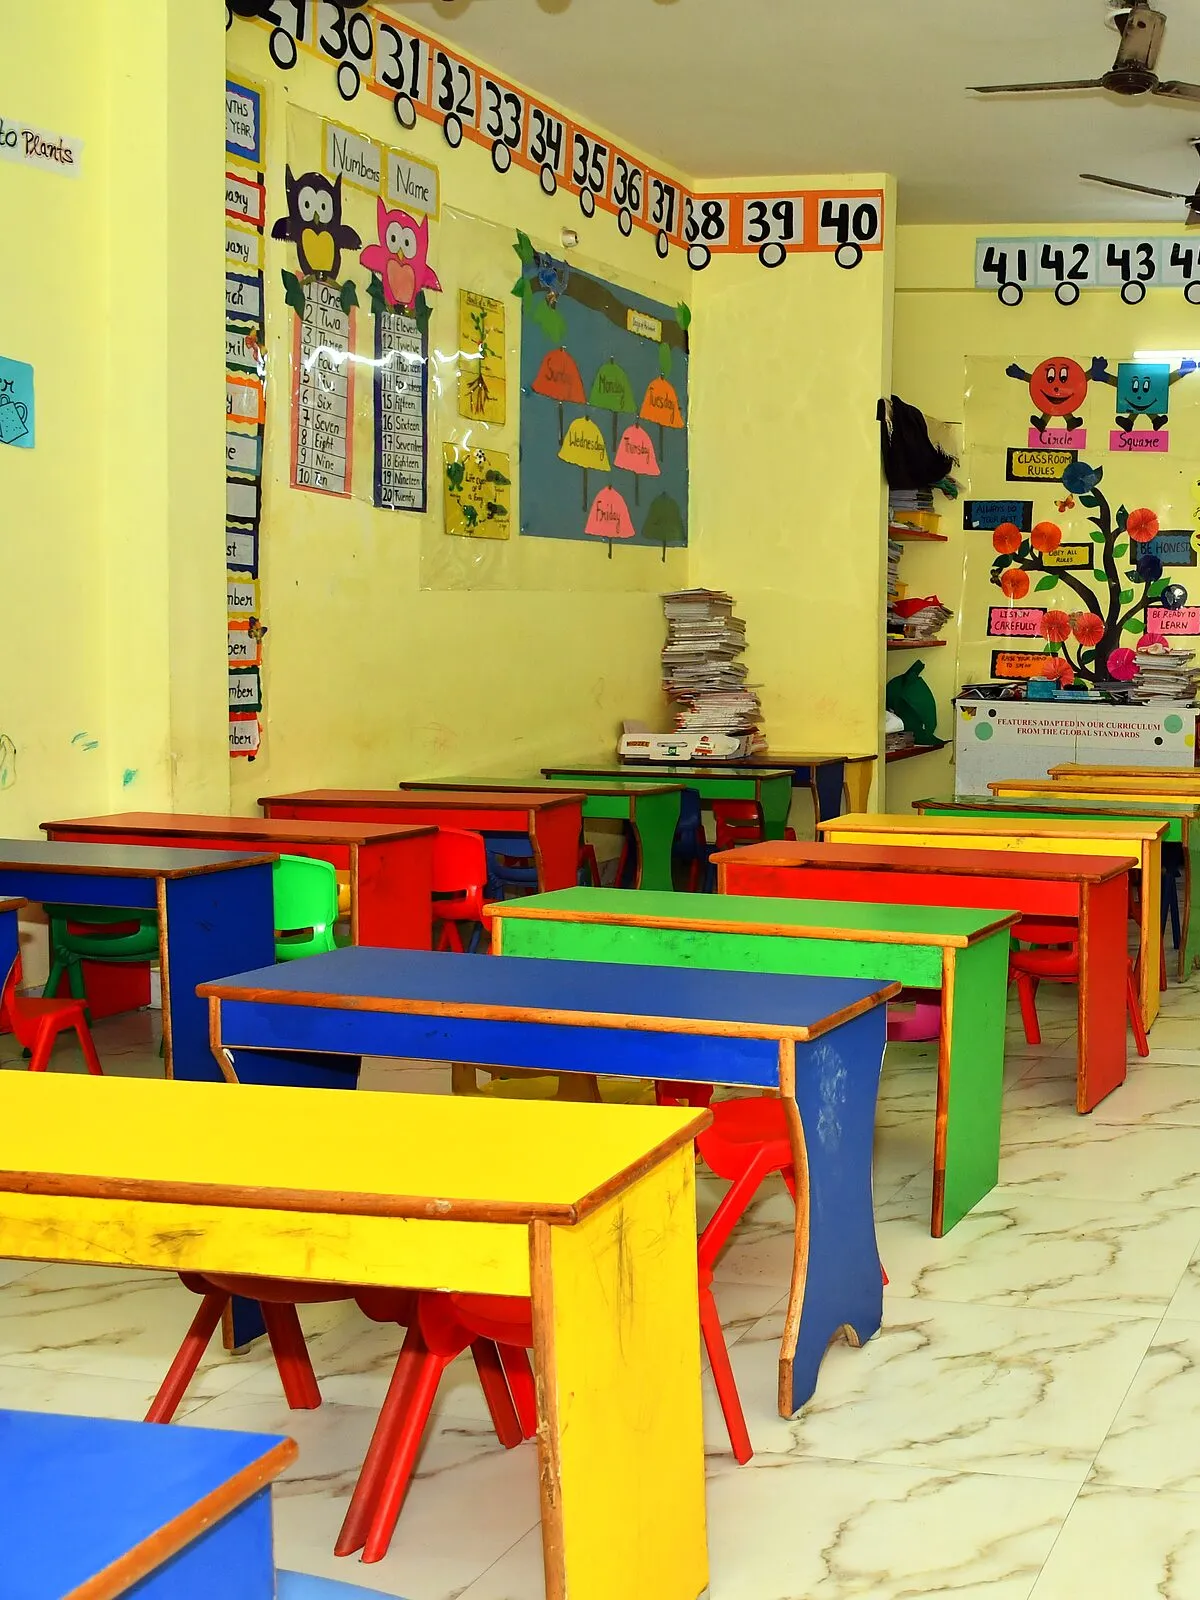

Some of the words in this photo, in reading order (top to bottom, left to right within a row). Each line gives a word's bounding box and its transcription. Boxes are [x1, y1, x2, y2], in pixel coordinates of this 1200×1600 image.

[319, 0, 373, 60] 30
[380, 23, 420, 99] 31
[437, 52, 476, 118] 32
[484, 80, 522, 147] 33
[530, 109, 563, 169] 34
[573, 133, 606, 193] 35
[614, 157, 641, 210] 36
[652, 179, 675, 232] 37
[22, 131, 74, 164] Plants
[333, 133, 380, 183] Numbers
[396, 164, 429, 202] Name
[685, 198, 725, 242] 38
[747, 201, 794, 243] 39
[821, 201, 878, 243] 40
[982, 246, 1026, 284] 41
[1041, 243, 1090, 281] 42
[1107, 242, 1155, 281] 43
[306, 284, 312, 300] 1
[303, 305, 313, 324] 2
[320, 310, 341, 330] Two
[382, 314, 392, 330] 11
[304, 326, 312, 344] 3
[383, 333, 393, 350] 12
[303, 369, 310, 383] 5
[383, 373, 392, 390] 14
[302, 389, 308, 404] 6
[317, 394, 332, 411] Six
[598, 374, 625, 410] Monday
[382, 394, 392, 410] 15
[395, 395, 416, 413] Fifteen
[649, 386, 676, 424] Tuesday
[302, 409, 310, 426] 7
[315, 414, 340, 436] Seven
[383, 414, 393, 431] 16
[395, 416, 420, 431] Sixteen
[301, 429, 307, 446] 8
[315, 432, 334, 452] Eight
[383, 434, 393, 450] 17
[569, 431, 605, 461] Wednesday
[1038, 431, 1073, 447] Circle
[1119, 433, 1160, 450] Square
[624, 436, 650, 464] Thursday
[301, 448, 307, 465] 9
[315, 456, 334, 471] Nine
[383, 453, 392, 467] 18
[1018, 454, 1071, 465] CLASSROOM
[298, 468, 310, 484] 10
[383, 470, 392, 484] 19
[1027, 465, 1055, 476] RULES
[383, 487, 393, 502] 20
[395, 489, 415, 505] Twenty
[595, 501, 620, 534] Friday
[1140, 541, 1153, 554] BE
[1156, 542, 1191, 554] HONEST
[1152, 610, 1161, 619] BE
[1163, 610, 1186, 619] READY
[994, 621, 1037, 631] CAREFULLY
[1160, 620, 1188, 630] LEARN
[997, 718, 1037, 727] FEATURES
[1039, 719, 1075, 728] ADAPTED
[1077, 720, 1085, 728] IN
[1087, 721, 1105, 729] OUR
[1106, 722, 1161, 731] CURRICULUM
[1017, 727, 1042, 735] FROM
[1043, 728, 1058, 736] THE
[1059, 729, 1092, 737] GLOBAL
[1093, 730, 1140, 739] STANDARDS
